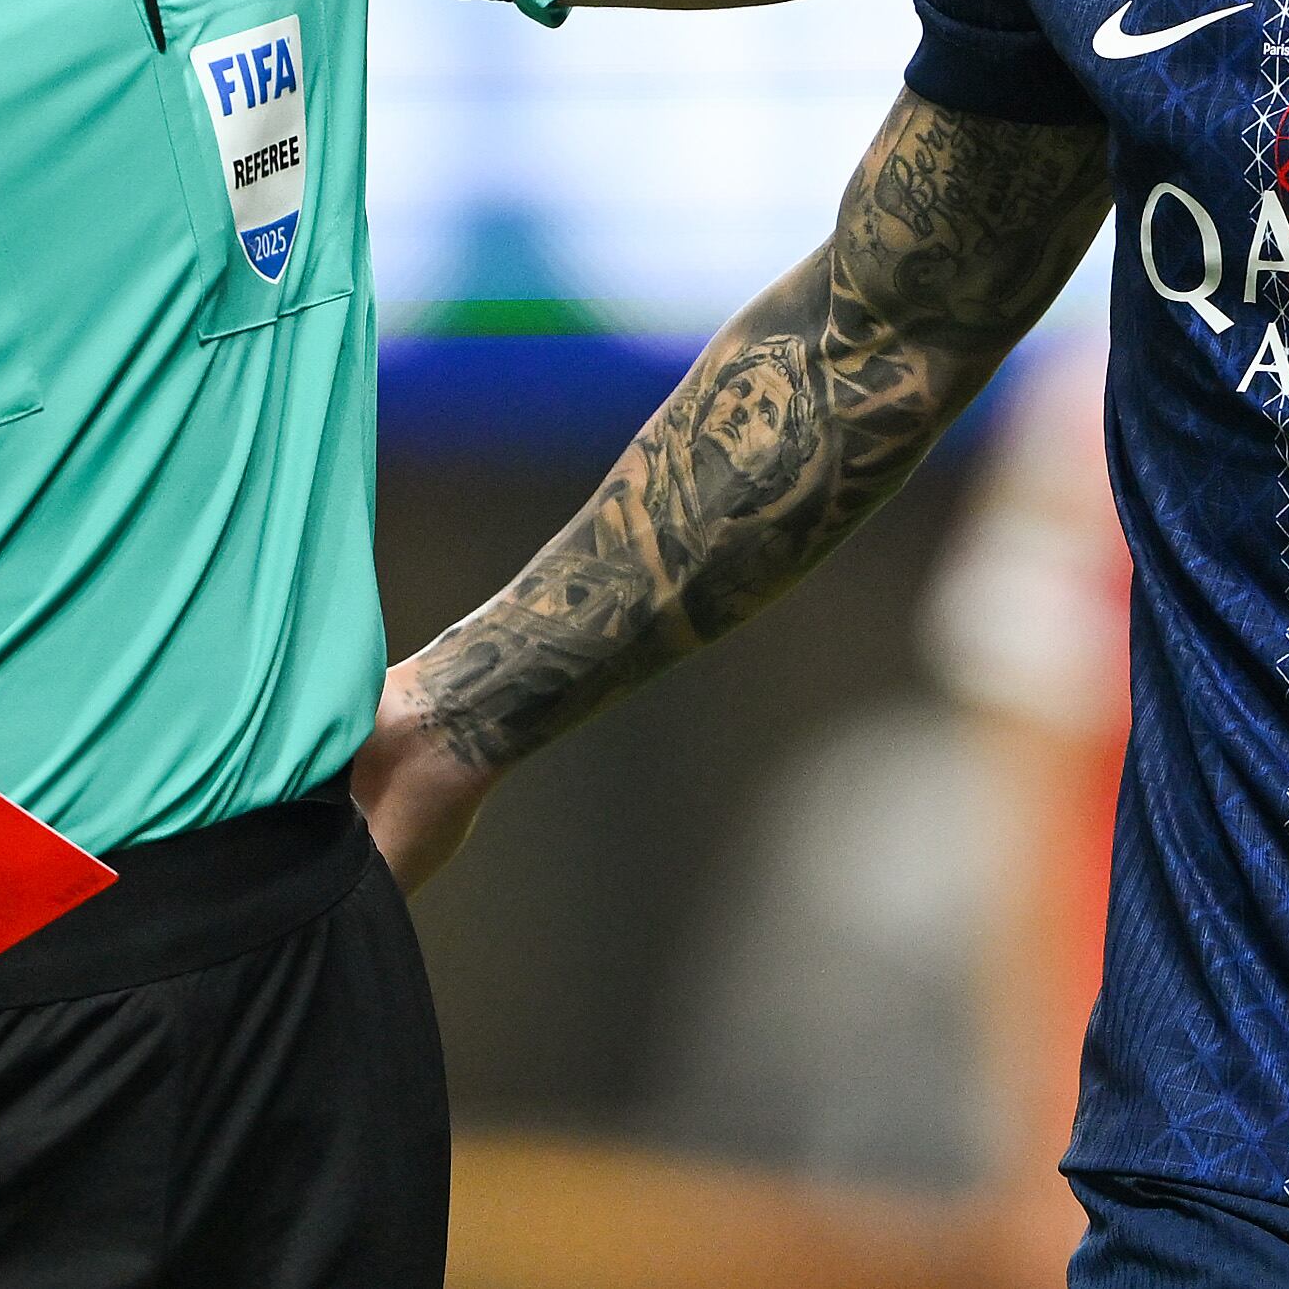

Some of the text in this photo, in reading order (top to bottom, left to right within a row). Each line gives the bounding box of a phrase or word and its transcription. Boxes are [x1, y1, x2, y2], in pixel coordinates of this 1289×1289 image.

[1263, 42, 1289, 56] Paris
[208, 37, 297, 117] FIFA
[232, 135, 300, 190] REFEREE
[254, 226, 287, 261] 2025
